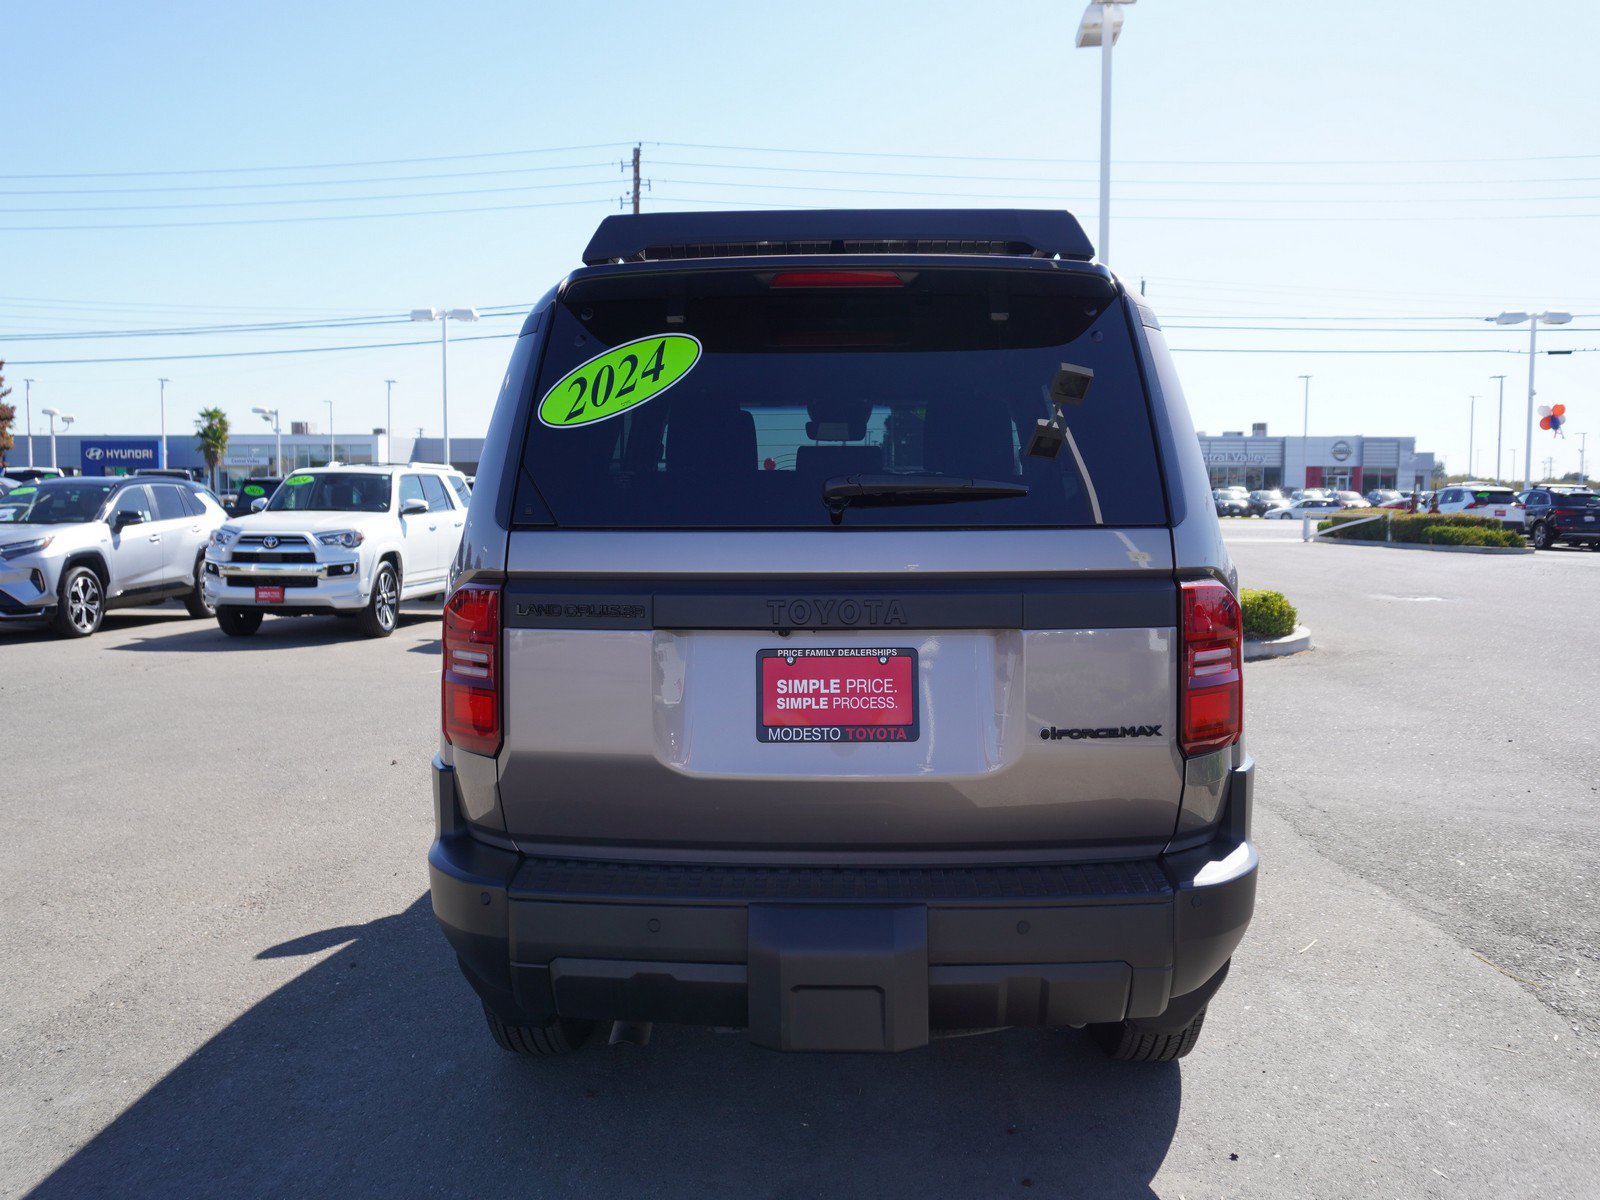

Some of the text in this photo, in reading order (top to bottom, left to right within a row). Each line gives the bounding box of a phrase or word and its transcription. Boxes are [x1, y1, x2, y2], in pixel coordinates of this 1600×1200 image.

[564, 340, 665, 422] 2024
[106, 449, 153, 459] HYUNDAI
[1231, 453, 1266, 463] Valley
[516, 604, 645, 618] LAND CRUISER
[767, 600, 908, 624] TOYOTA
[776, 679, 898, 694] SIMPLE PRICE.
[776, 697, 898, 709] SIMPLE PROCESS.
[768, 728, 907, 741] MODESTO TOYOTA
